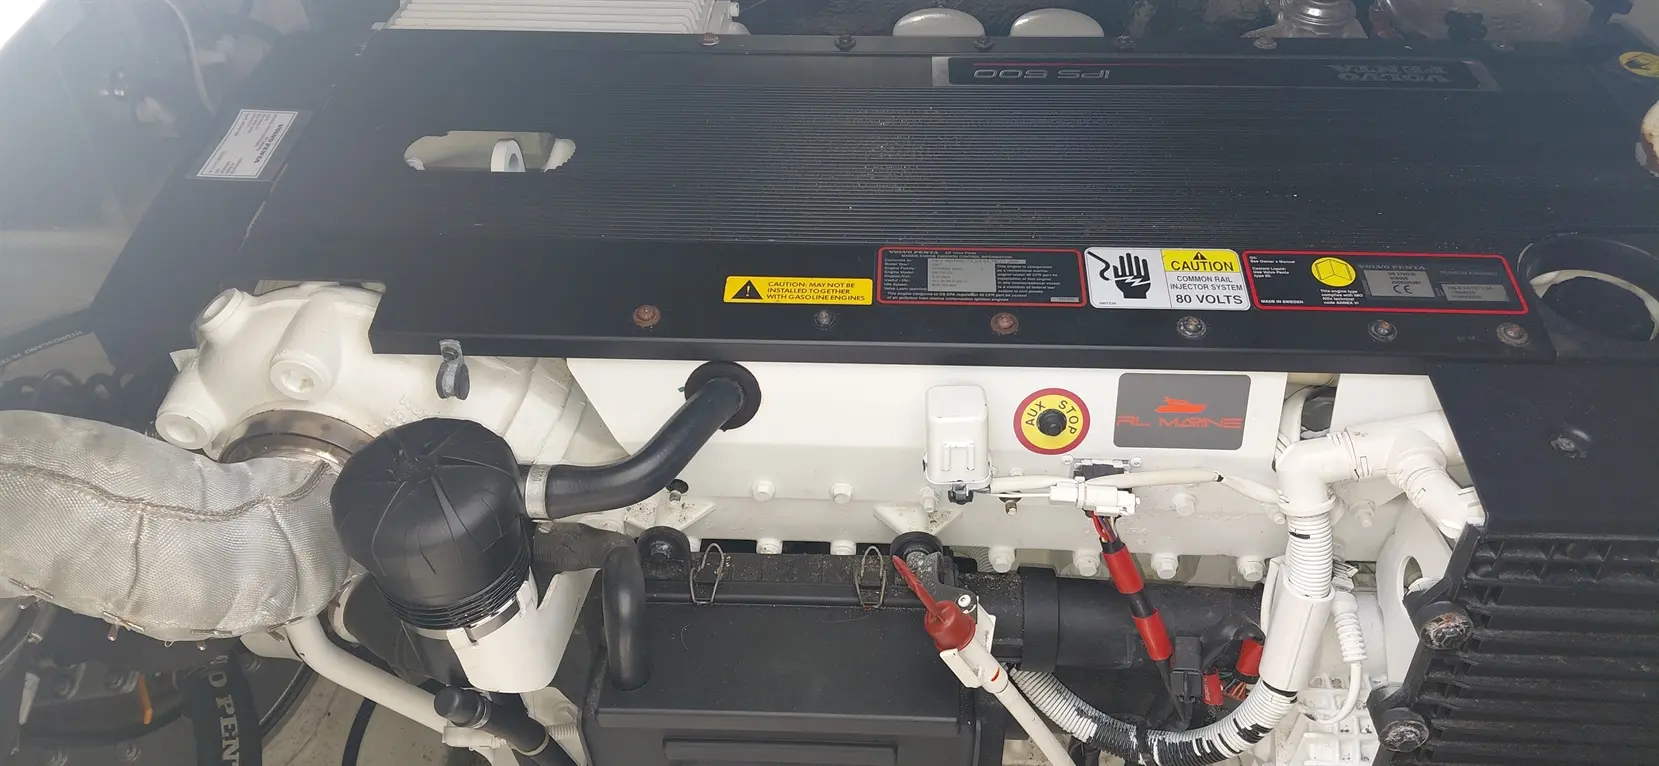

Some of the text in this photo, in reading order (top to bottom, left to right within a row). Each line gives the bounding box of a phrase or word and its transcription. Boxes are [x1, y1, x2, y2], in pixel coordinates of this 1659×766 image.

[1058, 69, 1111, 79] IPS
[1171, 260, 1234, 272] CAUTION
[1176, 294, 1243, 304] 80 VOLTS
[1025, 400, 1079, 434] AUX STOP
[1116, 416, 1244, 429] RL MARINE
